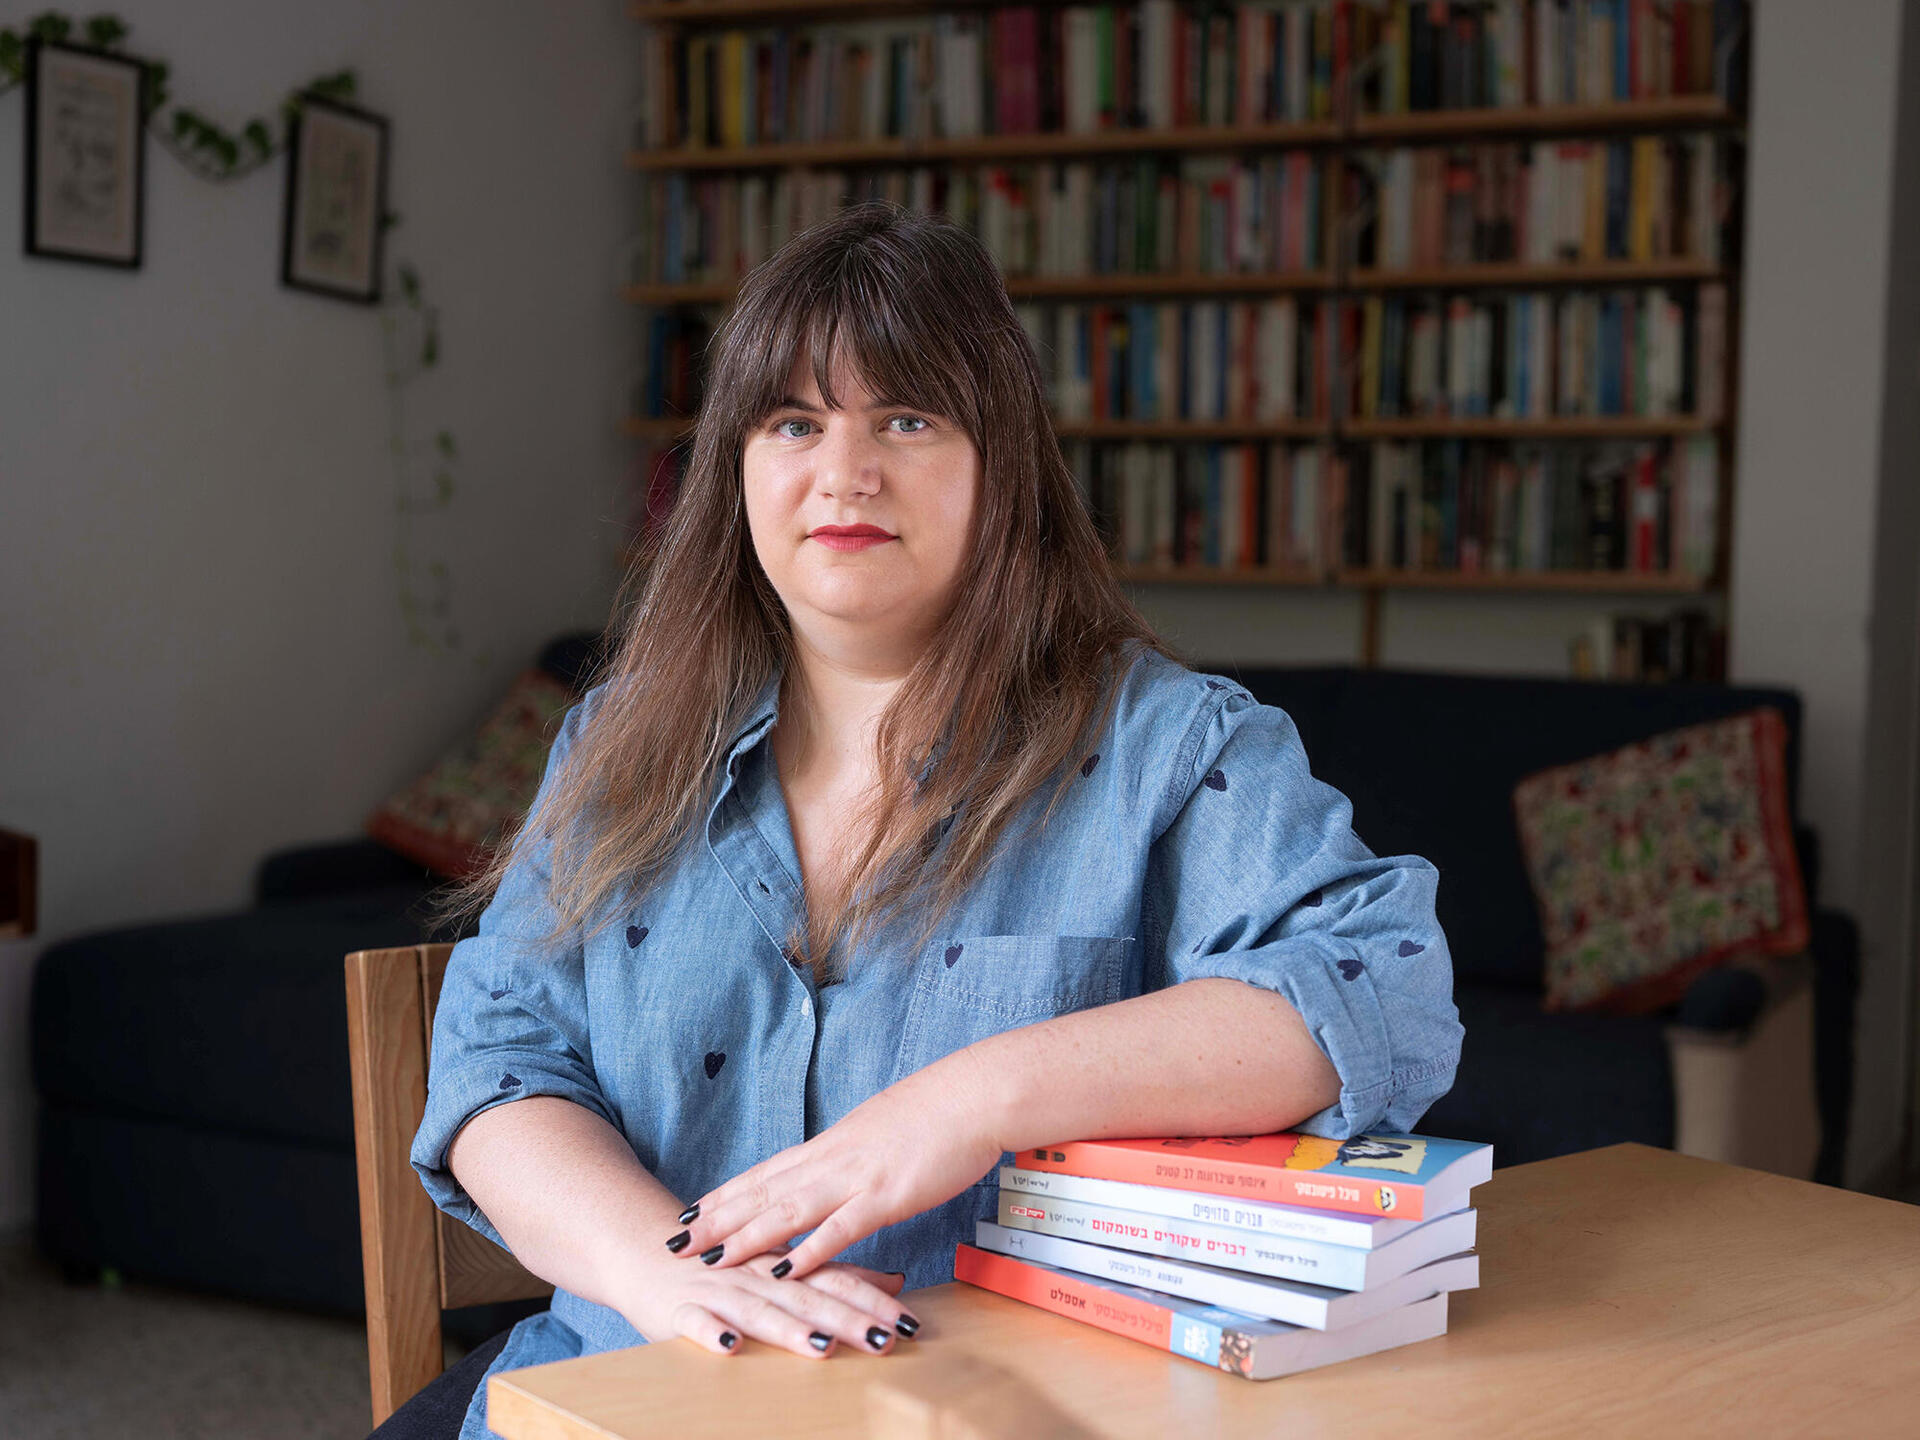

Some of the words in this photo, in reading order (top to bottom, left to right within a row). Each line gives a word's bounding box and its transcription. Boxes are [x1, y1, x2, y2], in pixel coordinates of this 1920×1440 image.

[1156, 1165, 1181, 1179] קטנים
[1183, 1168, 1194, 1180] לב
[1092, 1218, 1149, 1240] בשומקום
[1154, 1229, 1201, 1249] שקורים
[1207, 1237, 1247, 1257] דברים
[1050, 1287, 1087, 1310] אספלט
